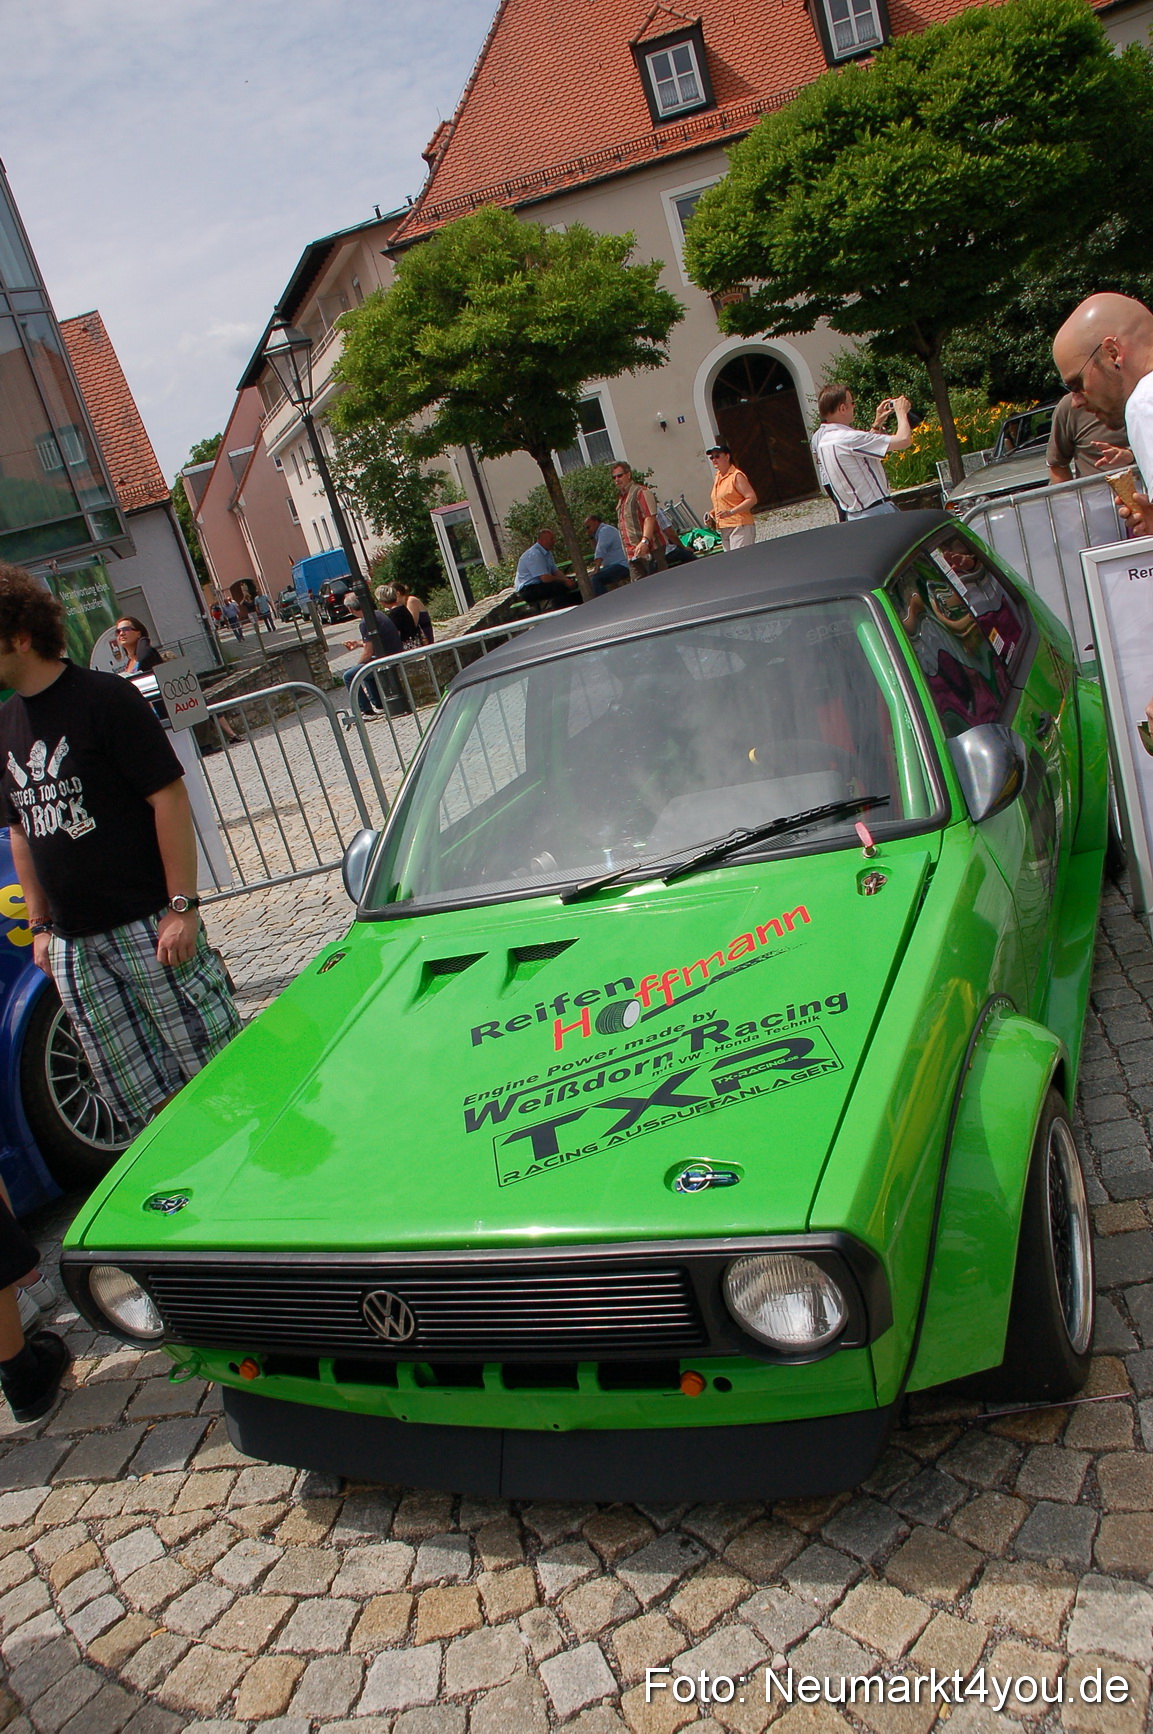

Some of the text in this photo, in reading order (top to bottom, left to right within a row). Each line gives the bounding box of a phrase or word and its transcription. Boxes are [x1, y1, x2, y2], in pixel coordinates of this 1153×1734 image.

[175, 698, 199, 714] Audi
[31, 794, 88, 838] ROCK
[39, 783, 57, 802] TOO
[58, 776, 83, 797] OLD
[471, 976, 636, 1047] Reifen
[463, 1009, 718, 1106] Engine Power made by
[464, 992, 849, 1134] Weißdorn Racing
[651, 1062, 674, 1078] mit
[678, 1052, 702, 1065] VW
[714, 1033, 760, 1053] Honda
[764, 1015, 821, 1036] Technik
[500, 1037, 834, 1161] TXR
[503, 1060, 838, 1184] RACING AUSPUFFANLAGEN
[363, 1289, 415, 1341] VW
